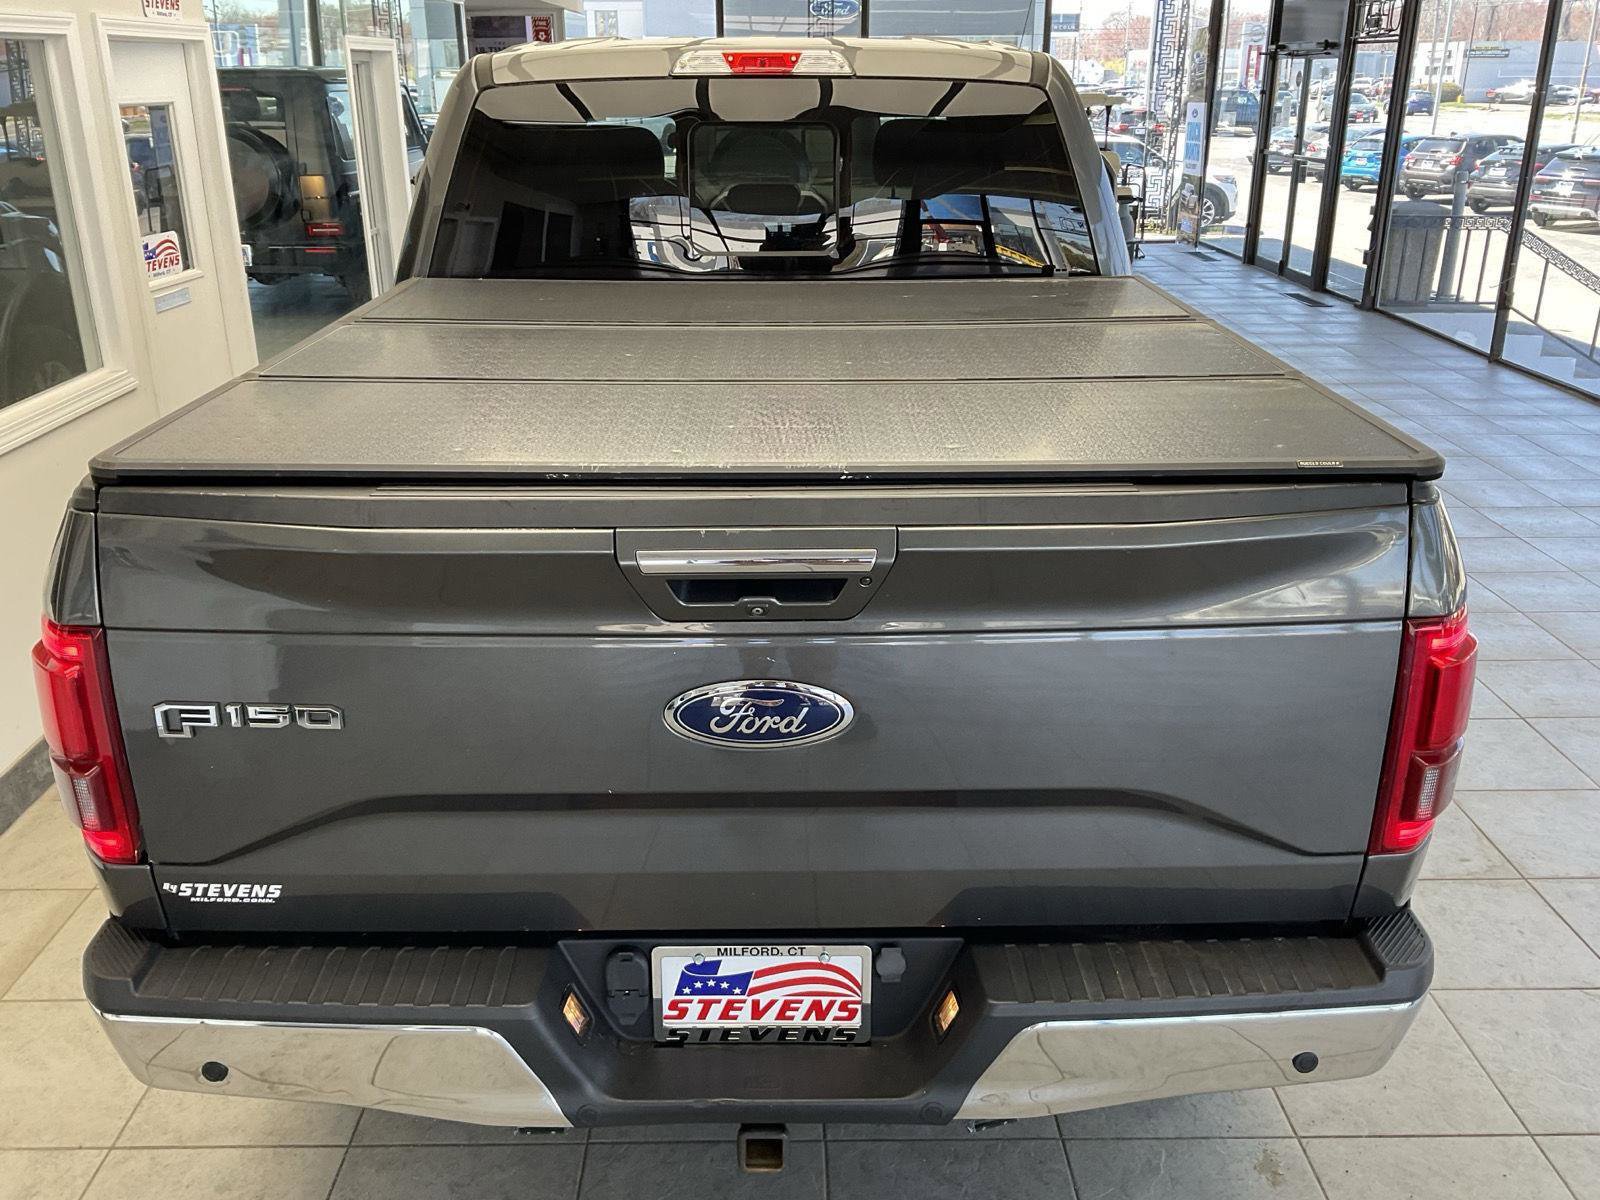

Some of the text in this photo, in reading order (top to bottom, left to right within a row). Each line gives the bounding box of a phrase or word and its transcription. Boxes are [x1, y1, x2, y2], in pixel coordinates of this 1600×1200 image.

[145, 0, 180, 10] STEVENS
[146, 255, 180, 272] TEVENS
[709, 697, 808, 733] Ford
[178, 883, 282, 898] STEVENS
[787, 947, 806, 956] CT
[663, 999, 861, 1021] STEVENS
[665, 1027, 857, 1042] STEVENS
